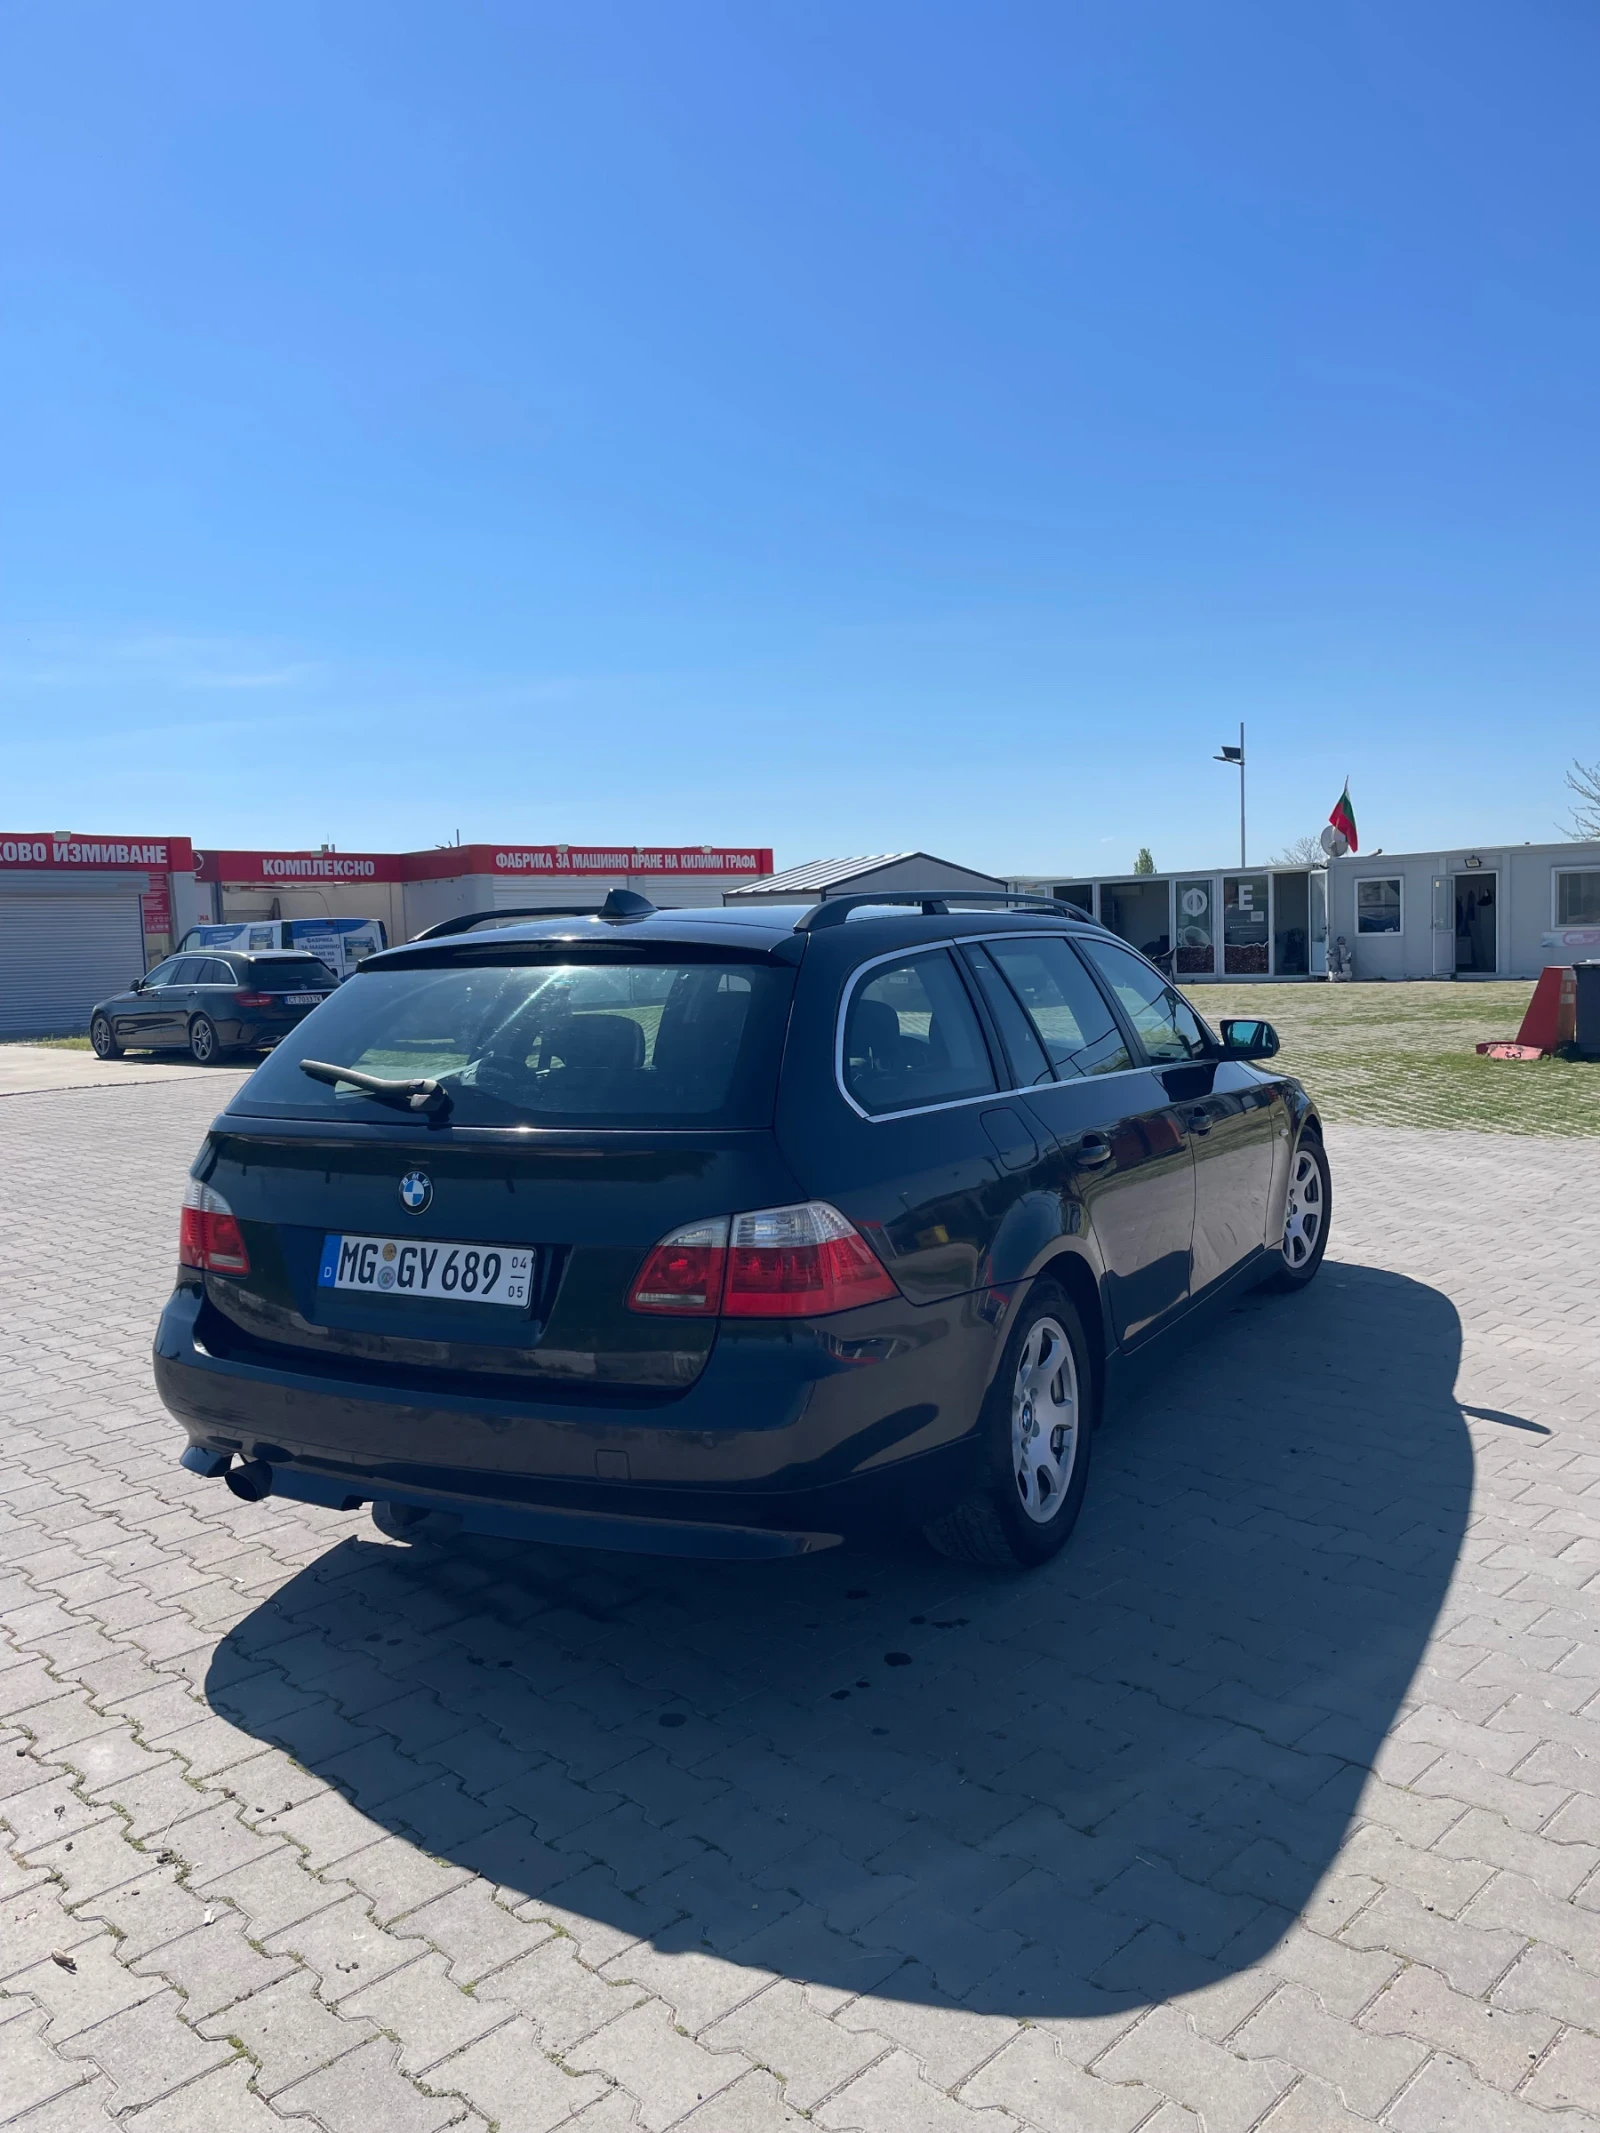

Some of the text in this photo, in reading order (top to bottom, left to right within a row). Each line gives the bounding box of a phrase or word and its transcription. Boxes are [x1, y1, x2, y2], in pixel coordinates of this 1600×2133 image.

[0, 842, 168, 864] ОВО ИЗМИВАНЕ
[495, 852, 756, 868] ФАБРИКА ЗА МАШИННО ПРАНЕ НА КИЛИМИ ГРАФА
[262, 859, 375, 876] КОМПЛЕКСНО
[402, 1172, 430, 1188] BMW
[324, 1241, 501, 1295] D MG GY 689
[511, 1256, 527, 1269] 04
[508, 1286, 524, 1298] 05
